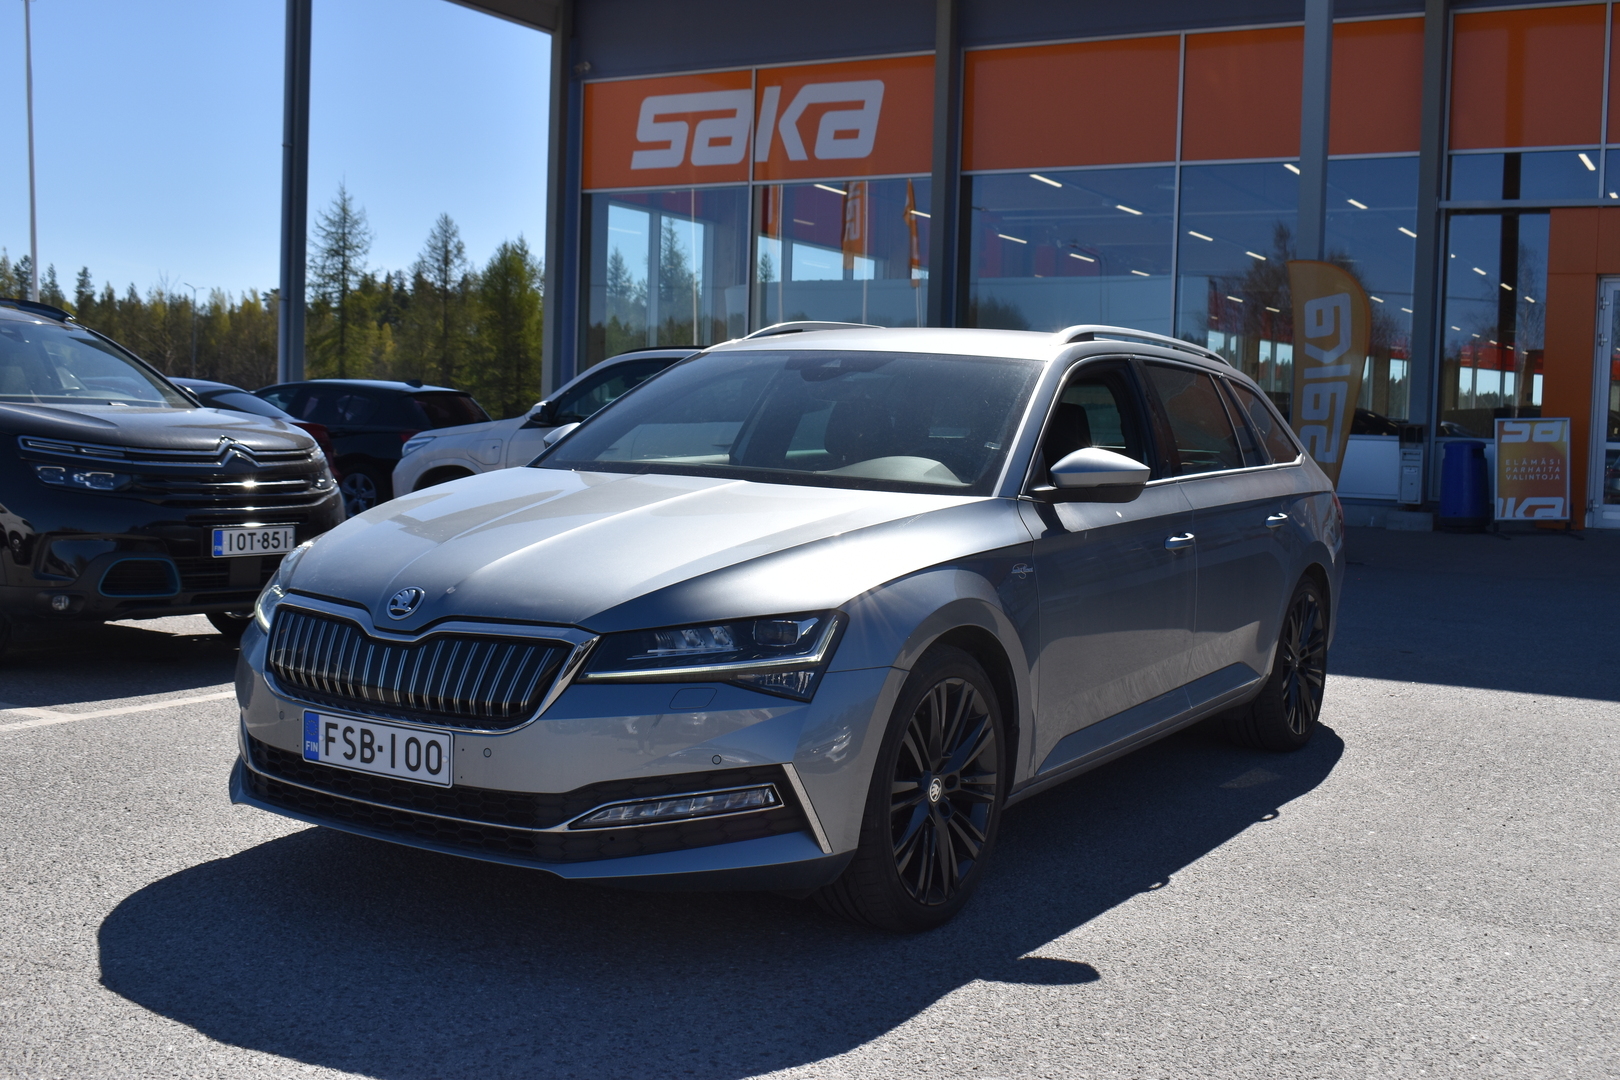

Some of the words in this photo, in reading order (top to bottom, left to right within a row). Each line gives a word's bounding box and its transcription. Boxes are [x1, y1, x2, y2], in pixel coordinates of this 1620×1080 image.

[1505, 458, 1561, 466] ELÄMÄSI
[1505, 473, 1561, 481] VALINTOJA
[305, 740, 318, 753] FIN
